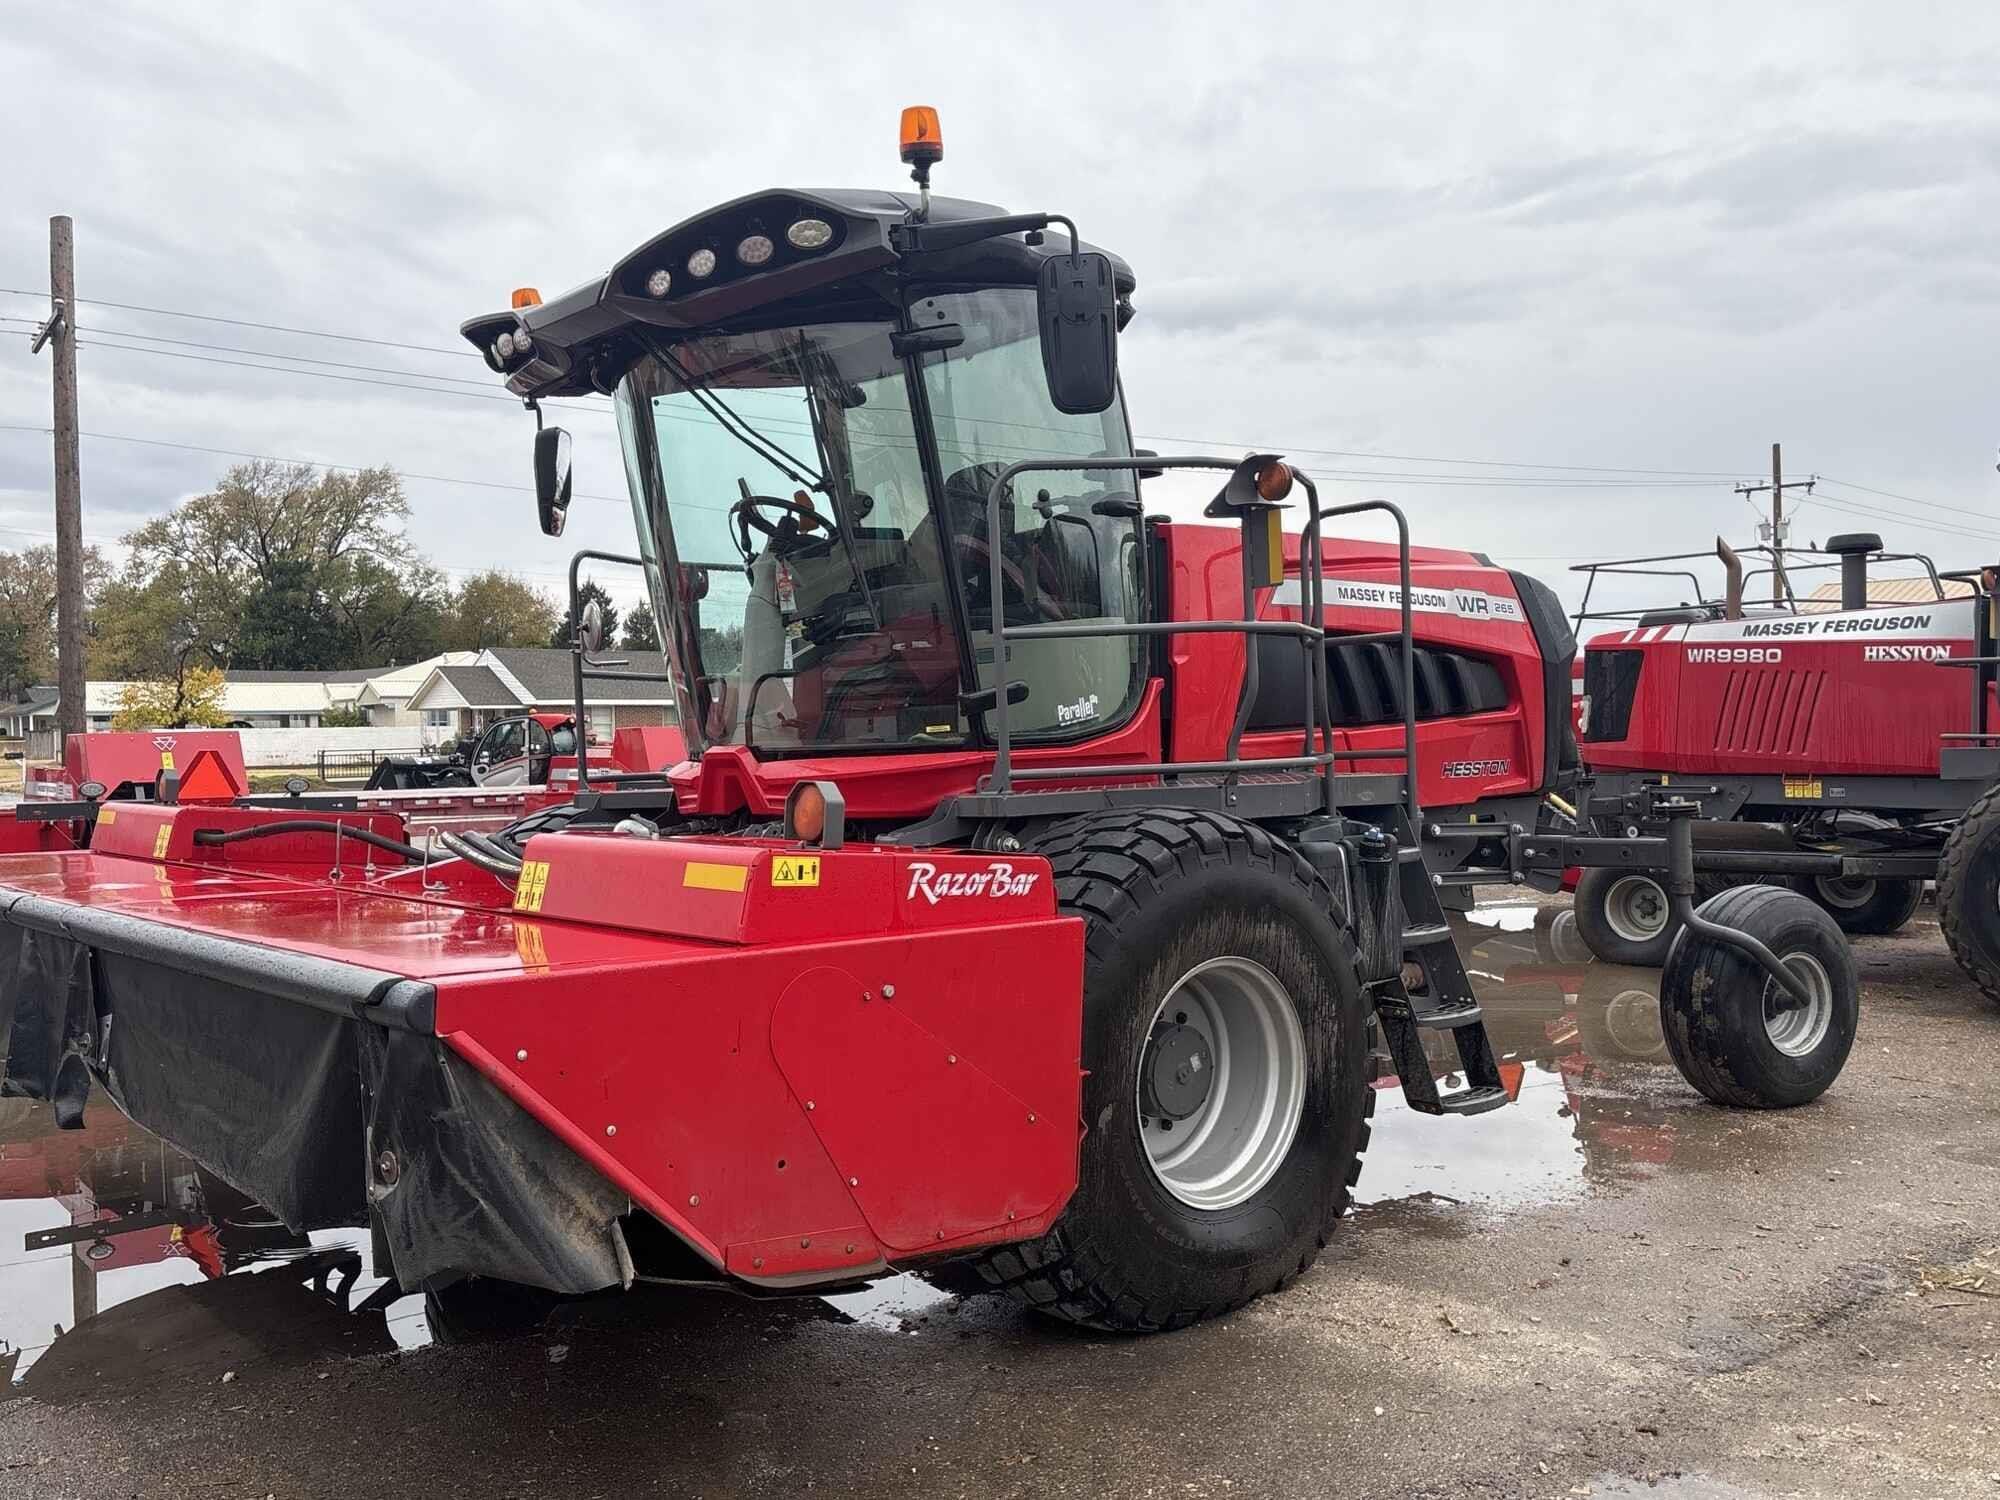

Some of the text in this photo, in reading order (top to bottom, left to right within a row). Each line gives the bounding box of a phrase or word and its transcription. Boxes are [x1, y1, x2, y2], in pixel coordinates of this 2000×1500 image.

[1337, 586, 1515, 614] MASSEY FEGUSON WR 265
[1742, 615, 1932, 637] MASSEY FERGUSON
[1687, 648, 1782, 664] WR9980
[1863, 645, 1952, 662] HESSTON
[1440, 759, 1511, 779] HESSTON
[906, 862, 1040, 905] RazorBar
